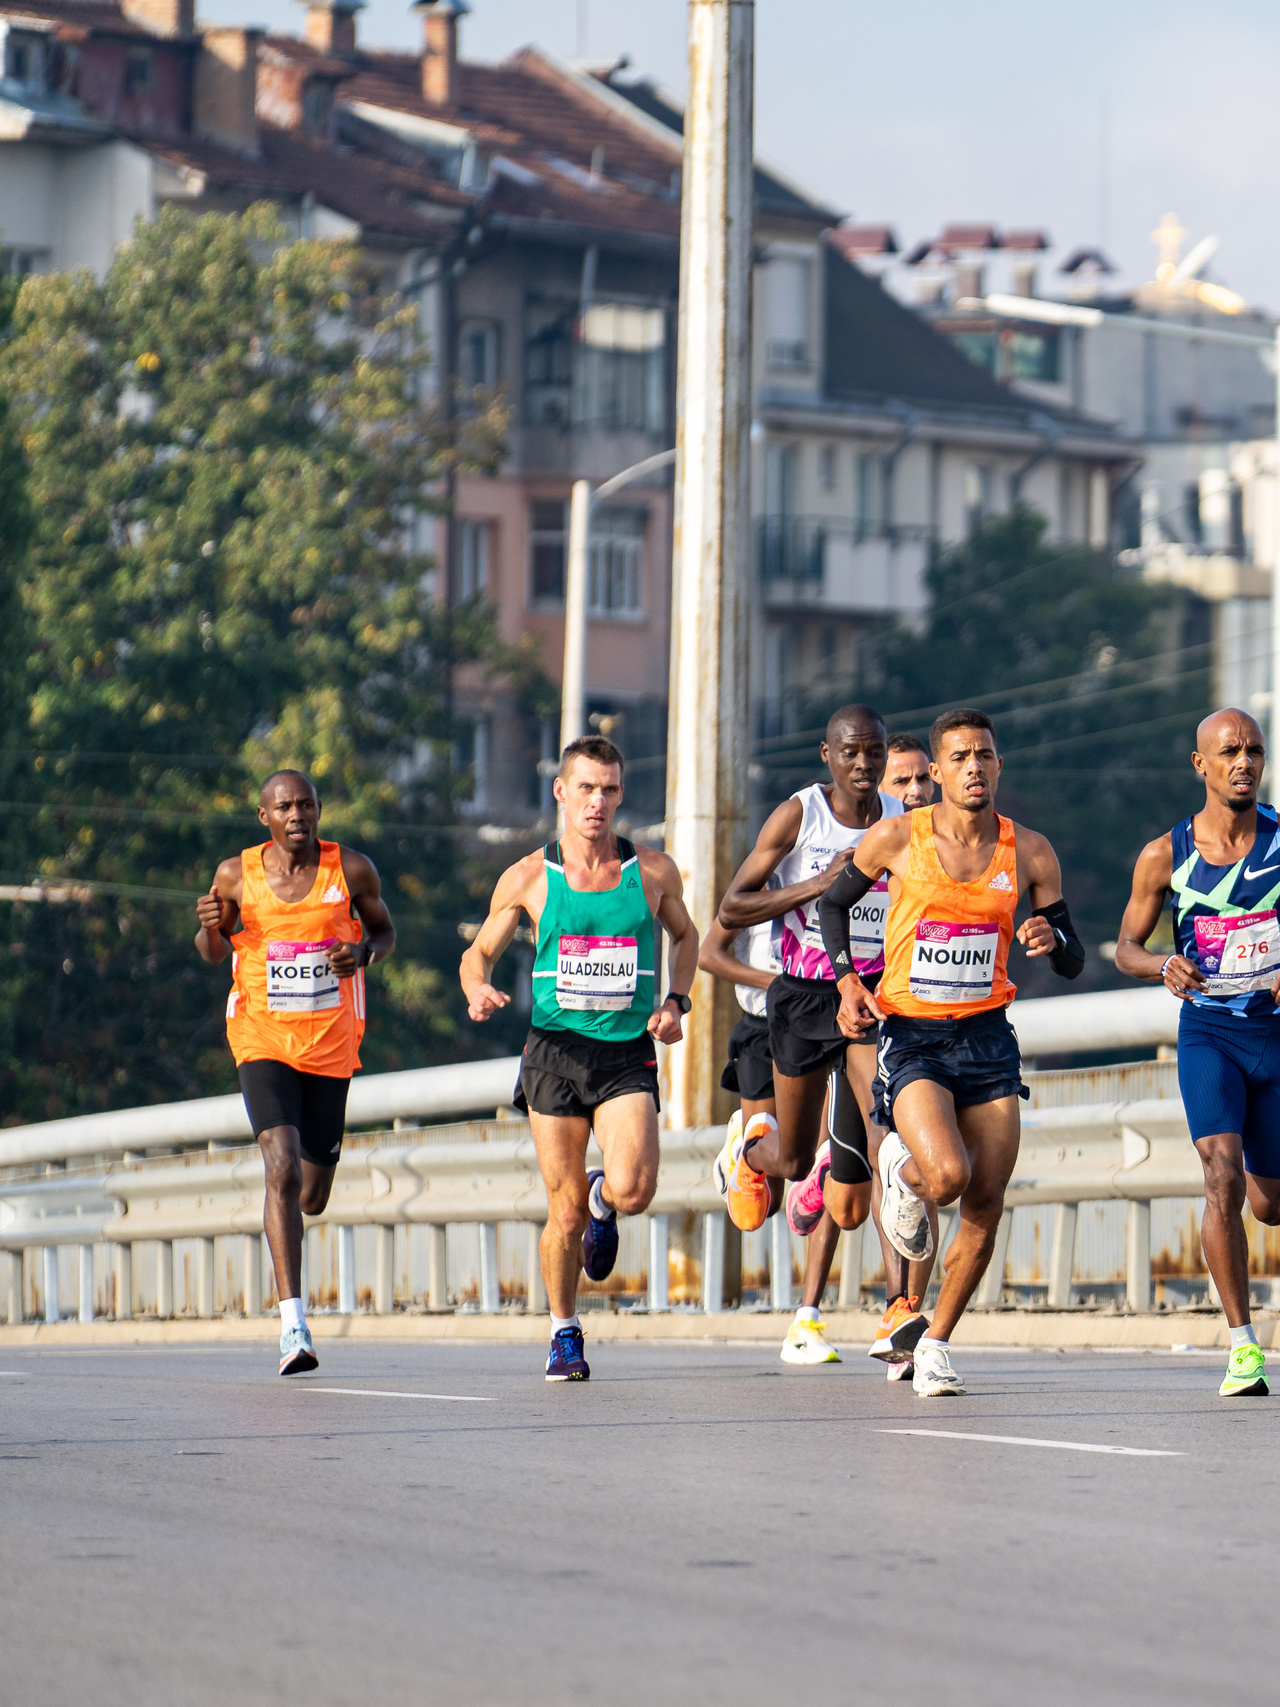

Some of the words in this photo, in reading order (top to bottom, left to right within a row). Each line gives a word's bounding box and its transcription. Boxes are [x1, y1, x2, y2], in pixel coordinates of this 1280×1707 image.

[988, 882, 1013, 892] adidas
[849, 905, 885, 923] OKOI
[917, 946, 992, 965] NOUINI
[1236, 941, 1269, 959] 276
[271, 963, 334, 979] KOECH
[560, 960, 634, 977] ULADZISLAU
